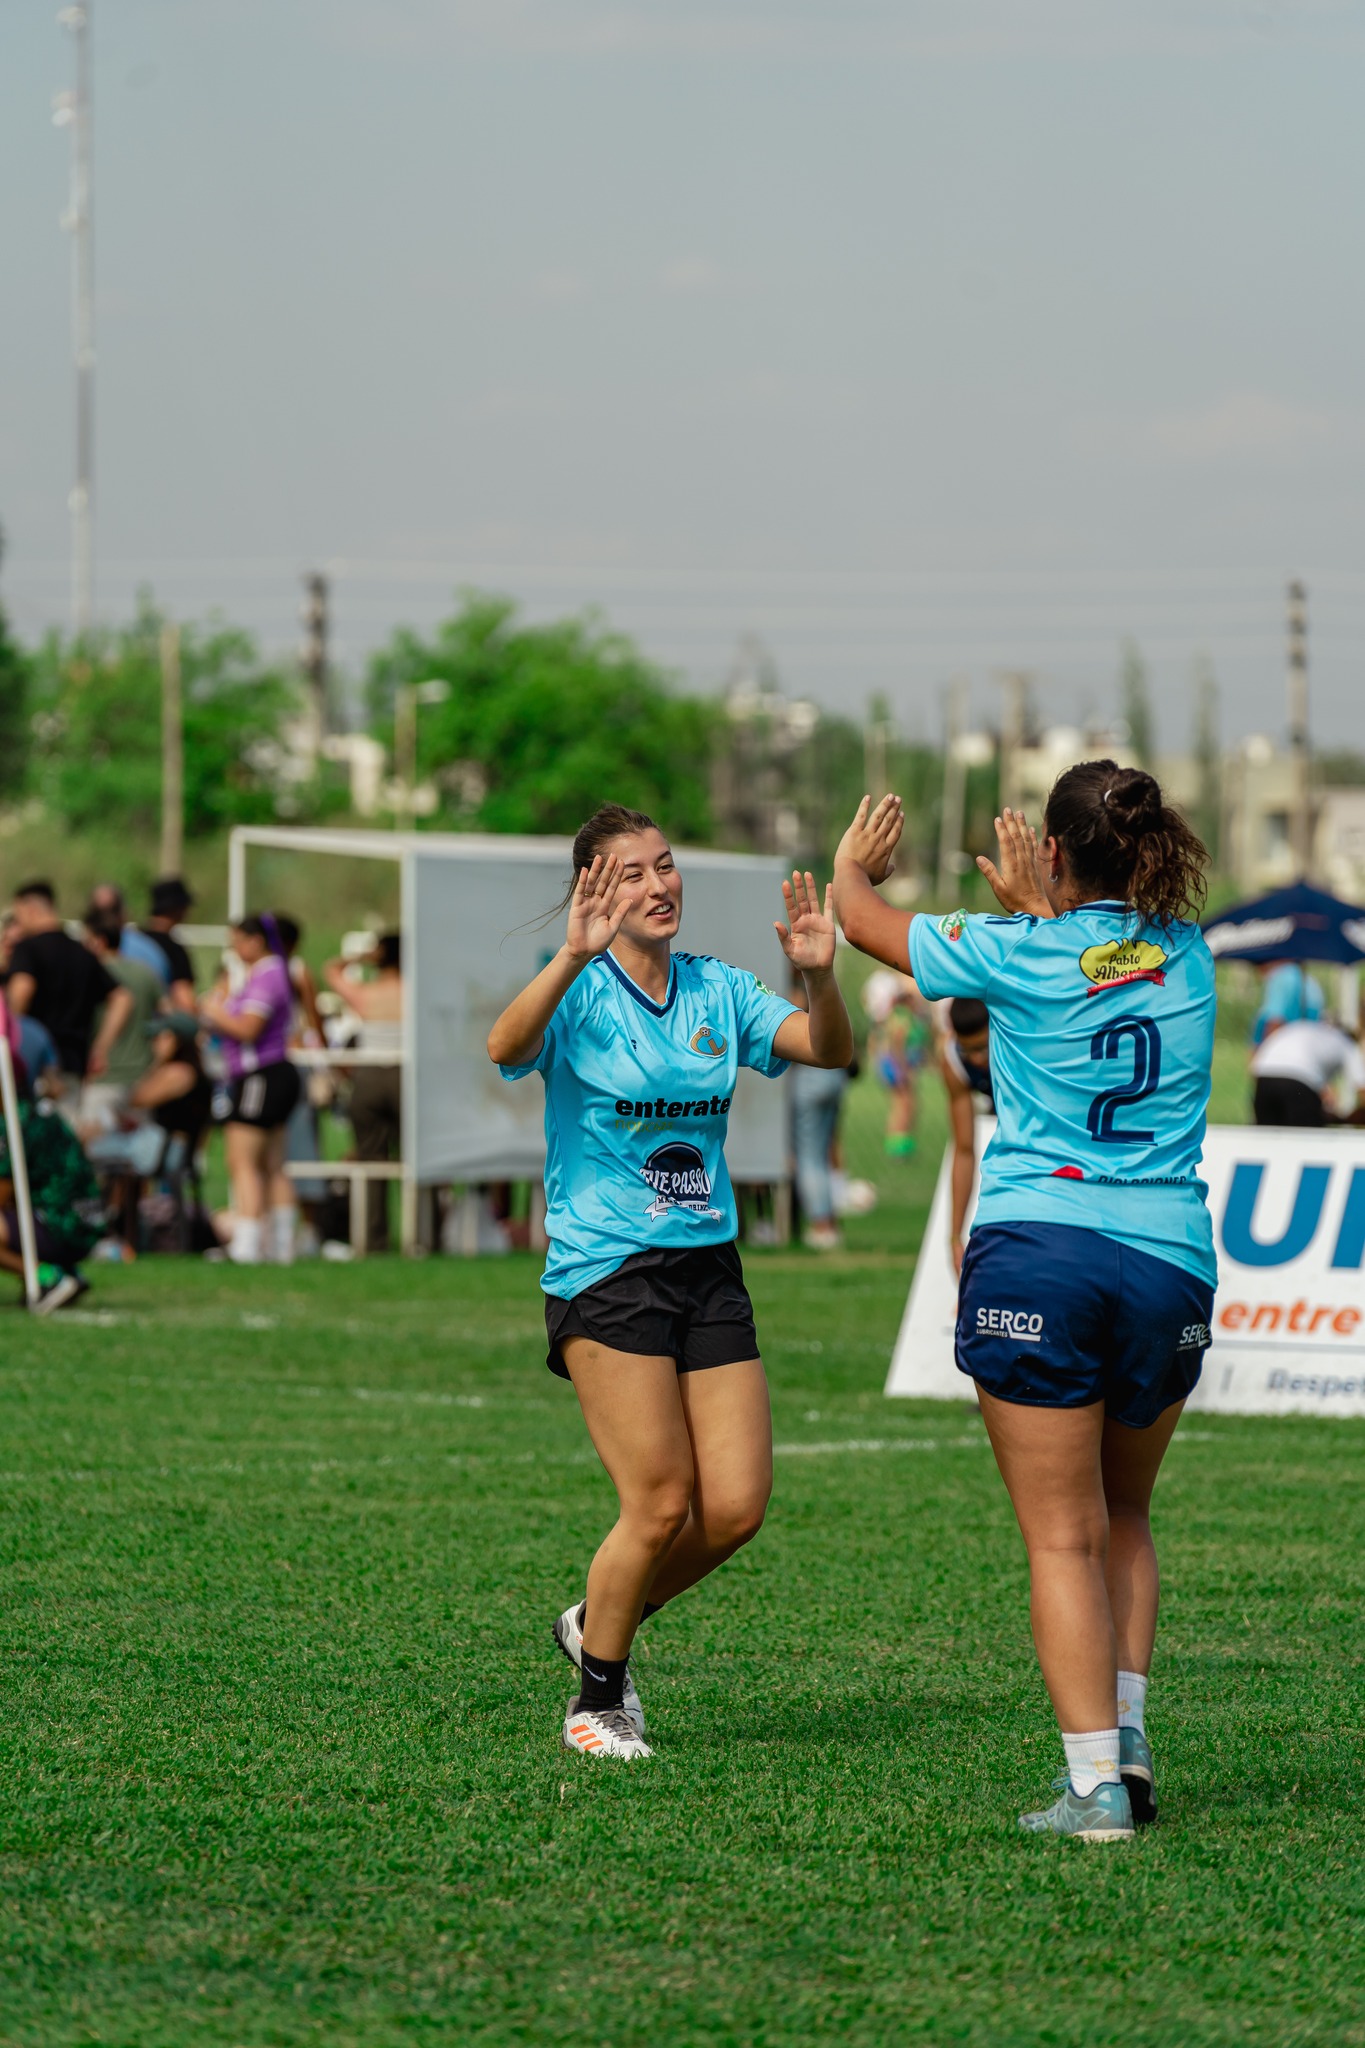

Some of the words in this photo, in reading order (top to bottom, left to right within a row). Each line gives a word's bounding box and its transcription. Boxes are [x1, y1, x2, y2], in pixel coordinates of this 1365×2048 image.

[1108, 953, 1141, 966] Pablo
[1086, 1014, 1162, 1147] 2
[615, 1095, 731, 1119] enterate
[976, 1307, 1044, 1342] SERCO
[1219, 1298, 1362, 1335] entre
[976, 1328, 1009, 1338] LUBRICANTES
